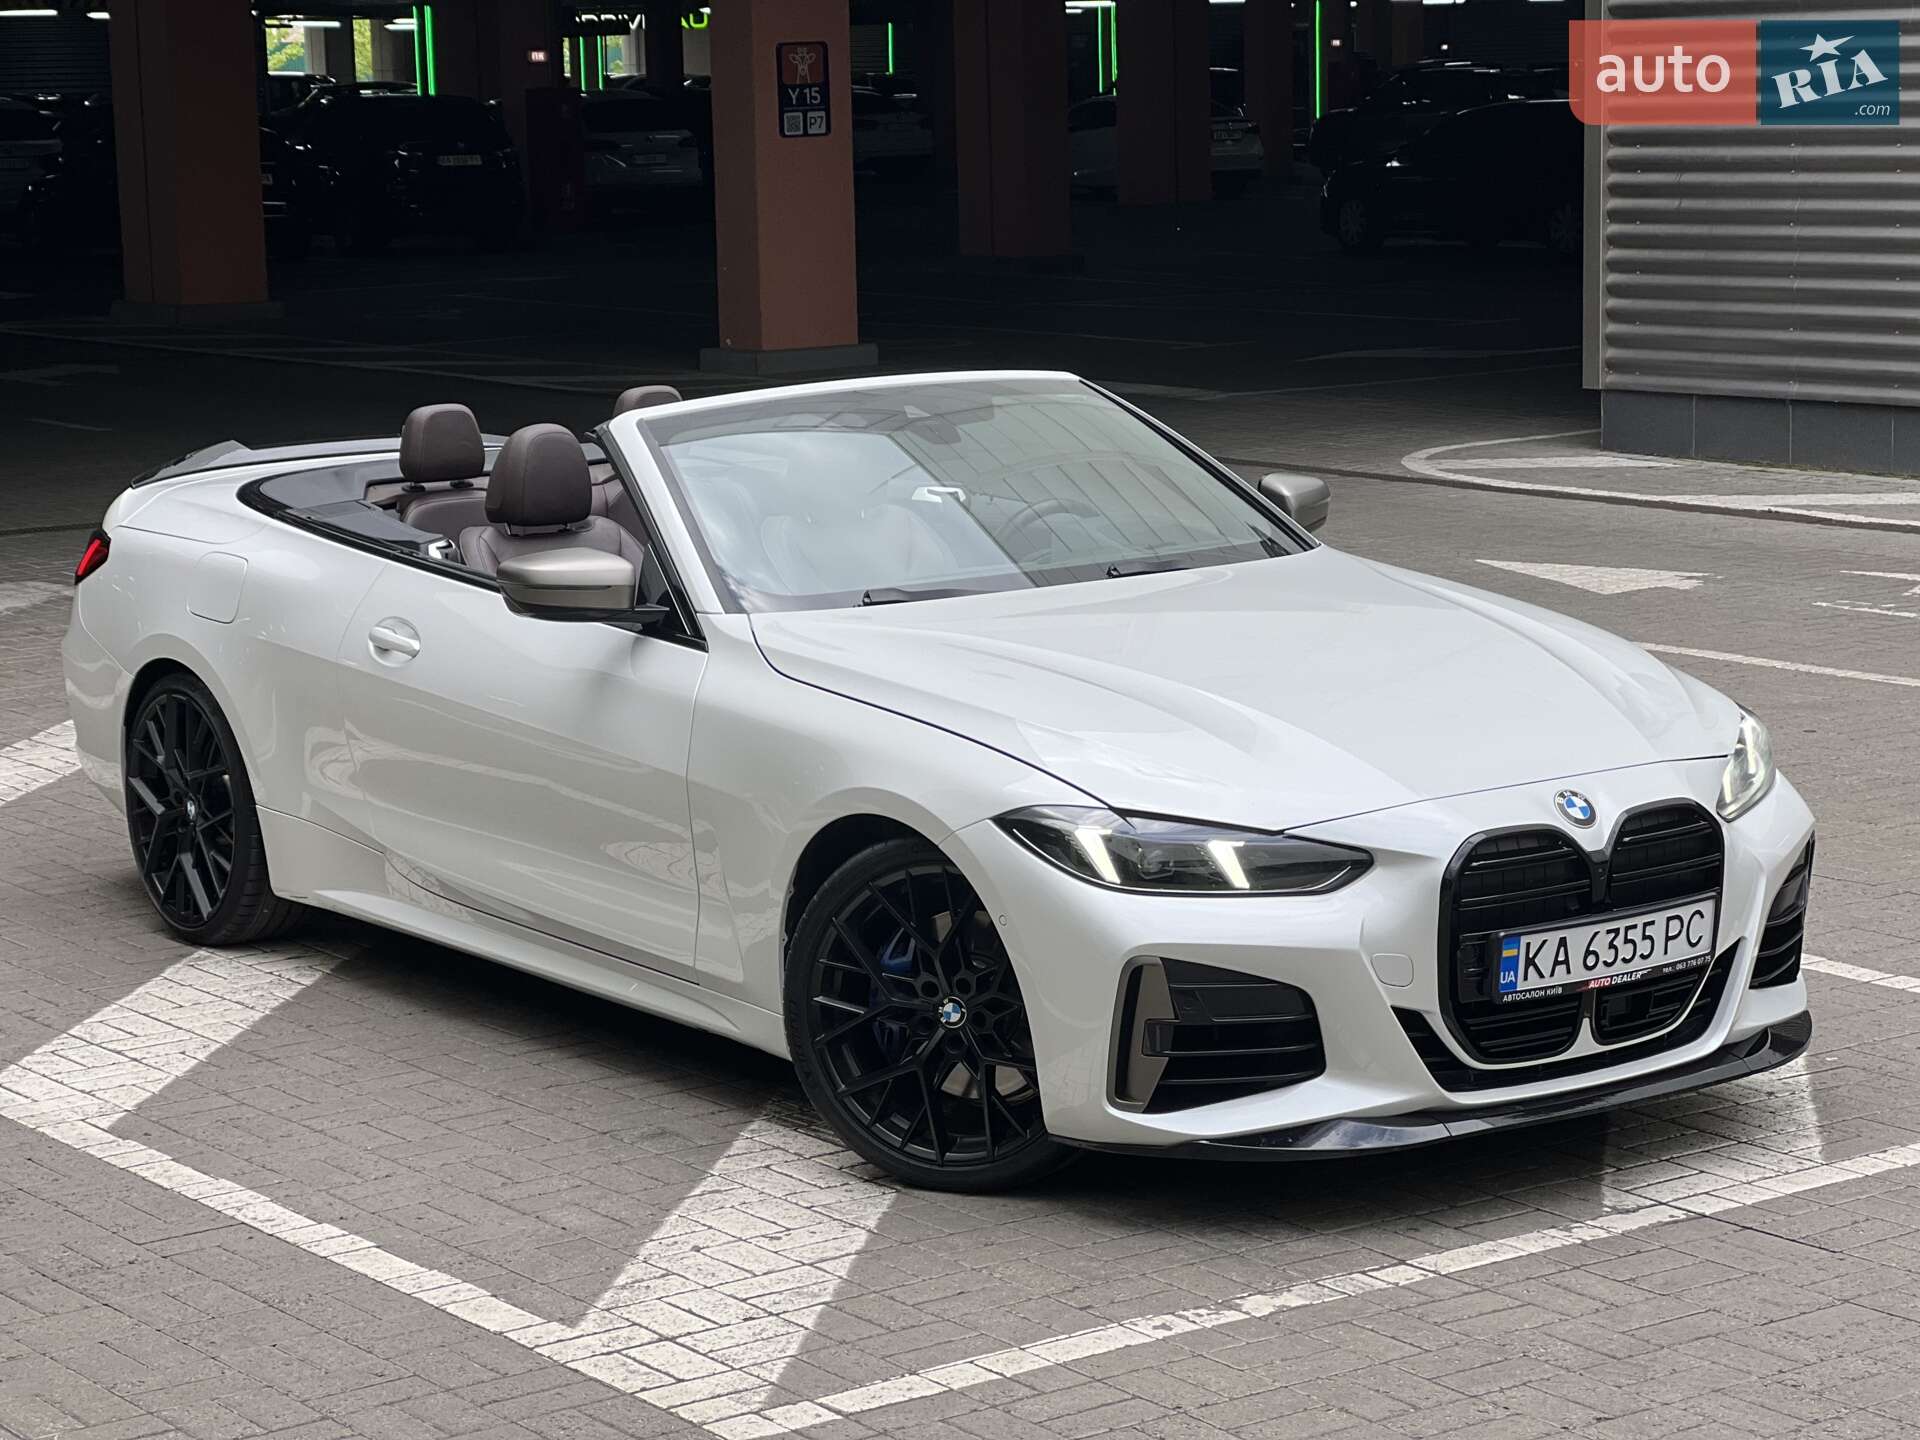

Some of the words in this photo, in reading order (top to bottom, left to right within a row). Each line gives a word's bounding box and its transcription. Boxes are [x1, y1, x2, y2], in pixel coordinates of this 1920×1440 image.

[788, 87, 800, 105] Y
[803, 86, 821, 105] 15
[809, 116, 825, 129] P7
[1523, 936, 1571, 982] KA
[1582, 920, 1656, 971] 6355
[1663, 909, 1705, 956] PC
[1500, 971, 1516, 984] UA
[1588, 977, 1611, 989] AUTO
[1611, 971, 1641, 985] DEALER
[1503, 989, 1545, 1003] АВТОСАЛОН
